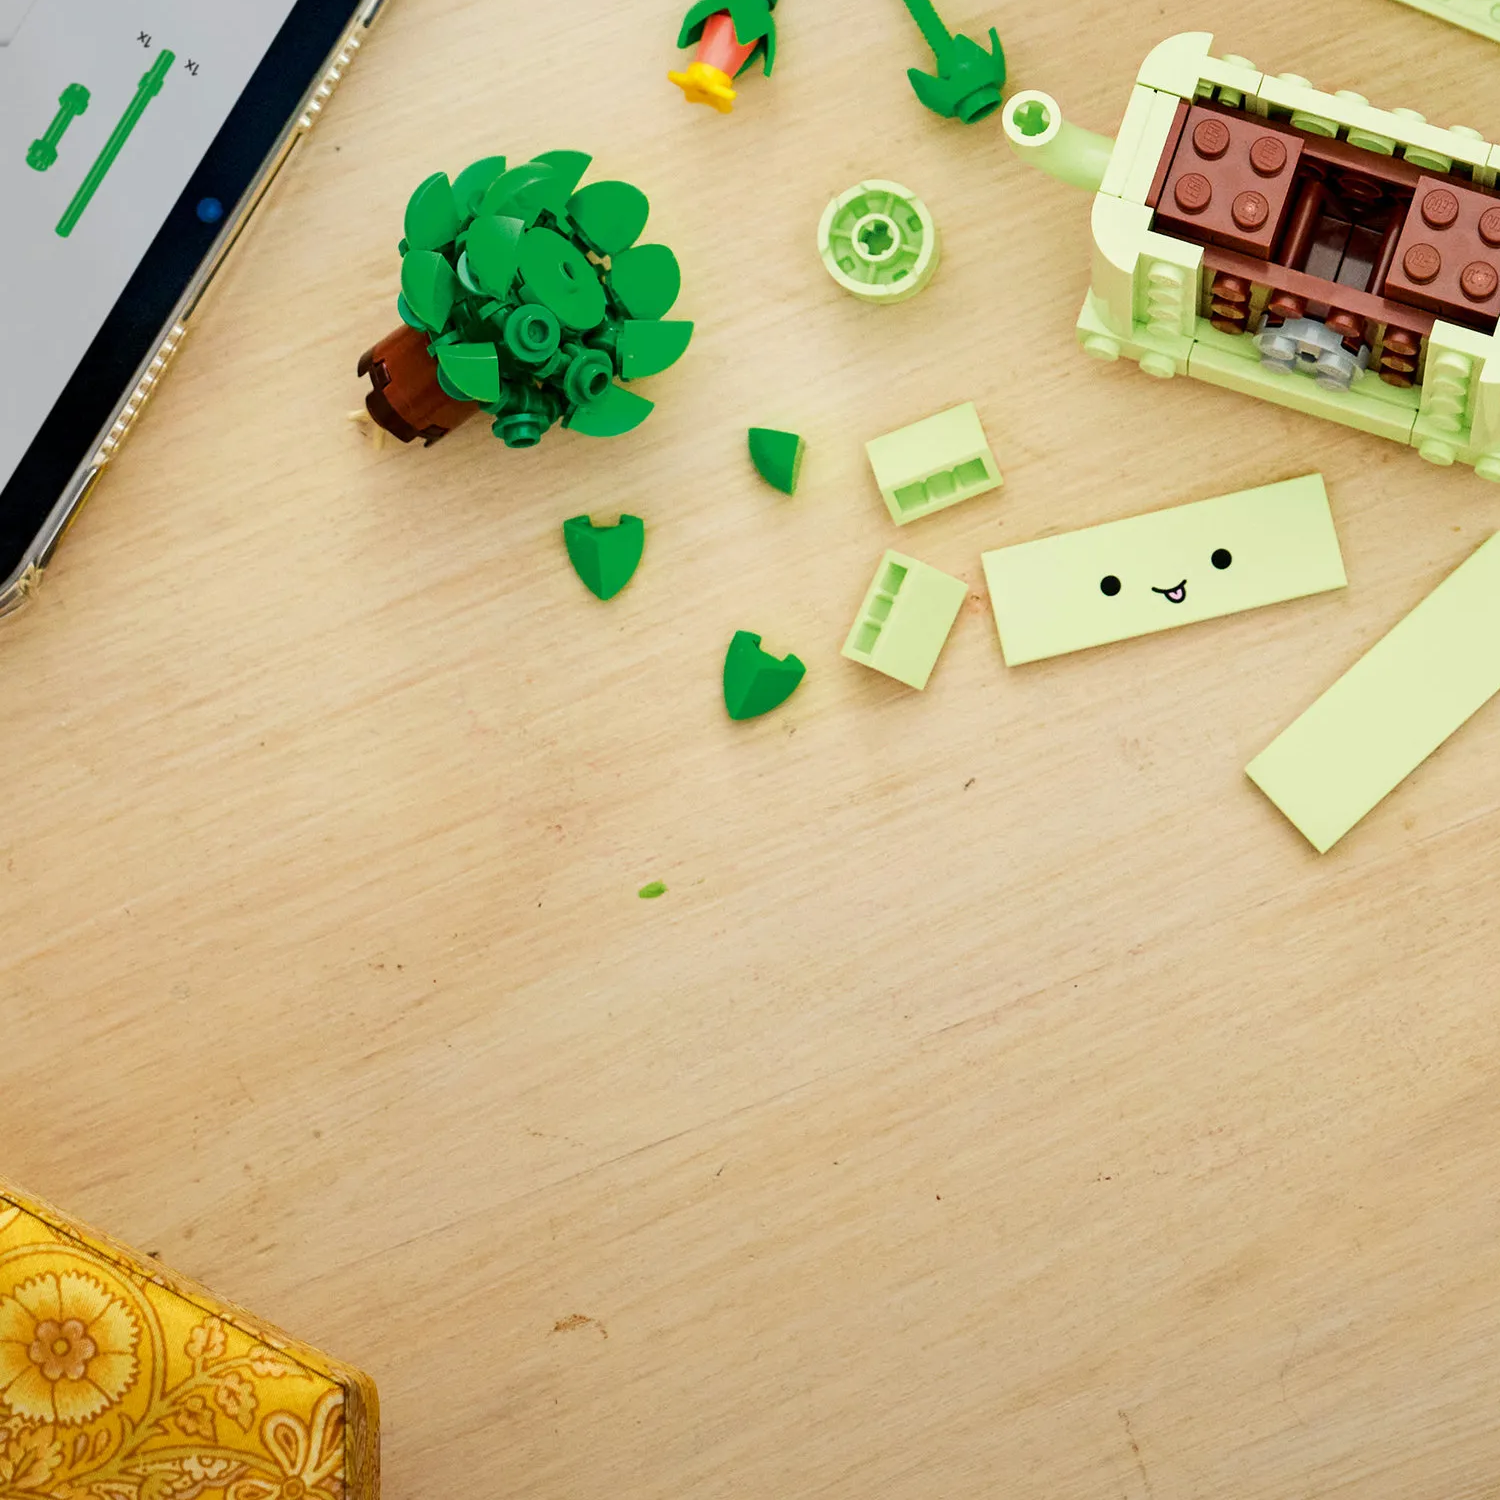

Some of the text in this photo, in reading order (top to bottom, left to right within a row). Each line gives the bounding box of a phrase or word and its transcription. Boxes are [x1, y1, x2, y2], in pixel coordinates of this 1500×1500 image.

[136, 30, 152, 48] 1x
[184, 58, 200, 76] 1x
[1240, 194, 1261, 222] LO
[1425, 196, 1456, 216] LEGO
[1465, 268, 1495, 288] LO
